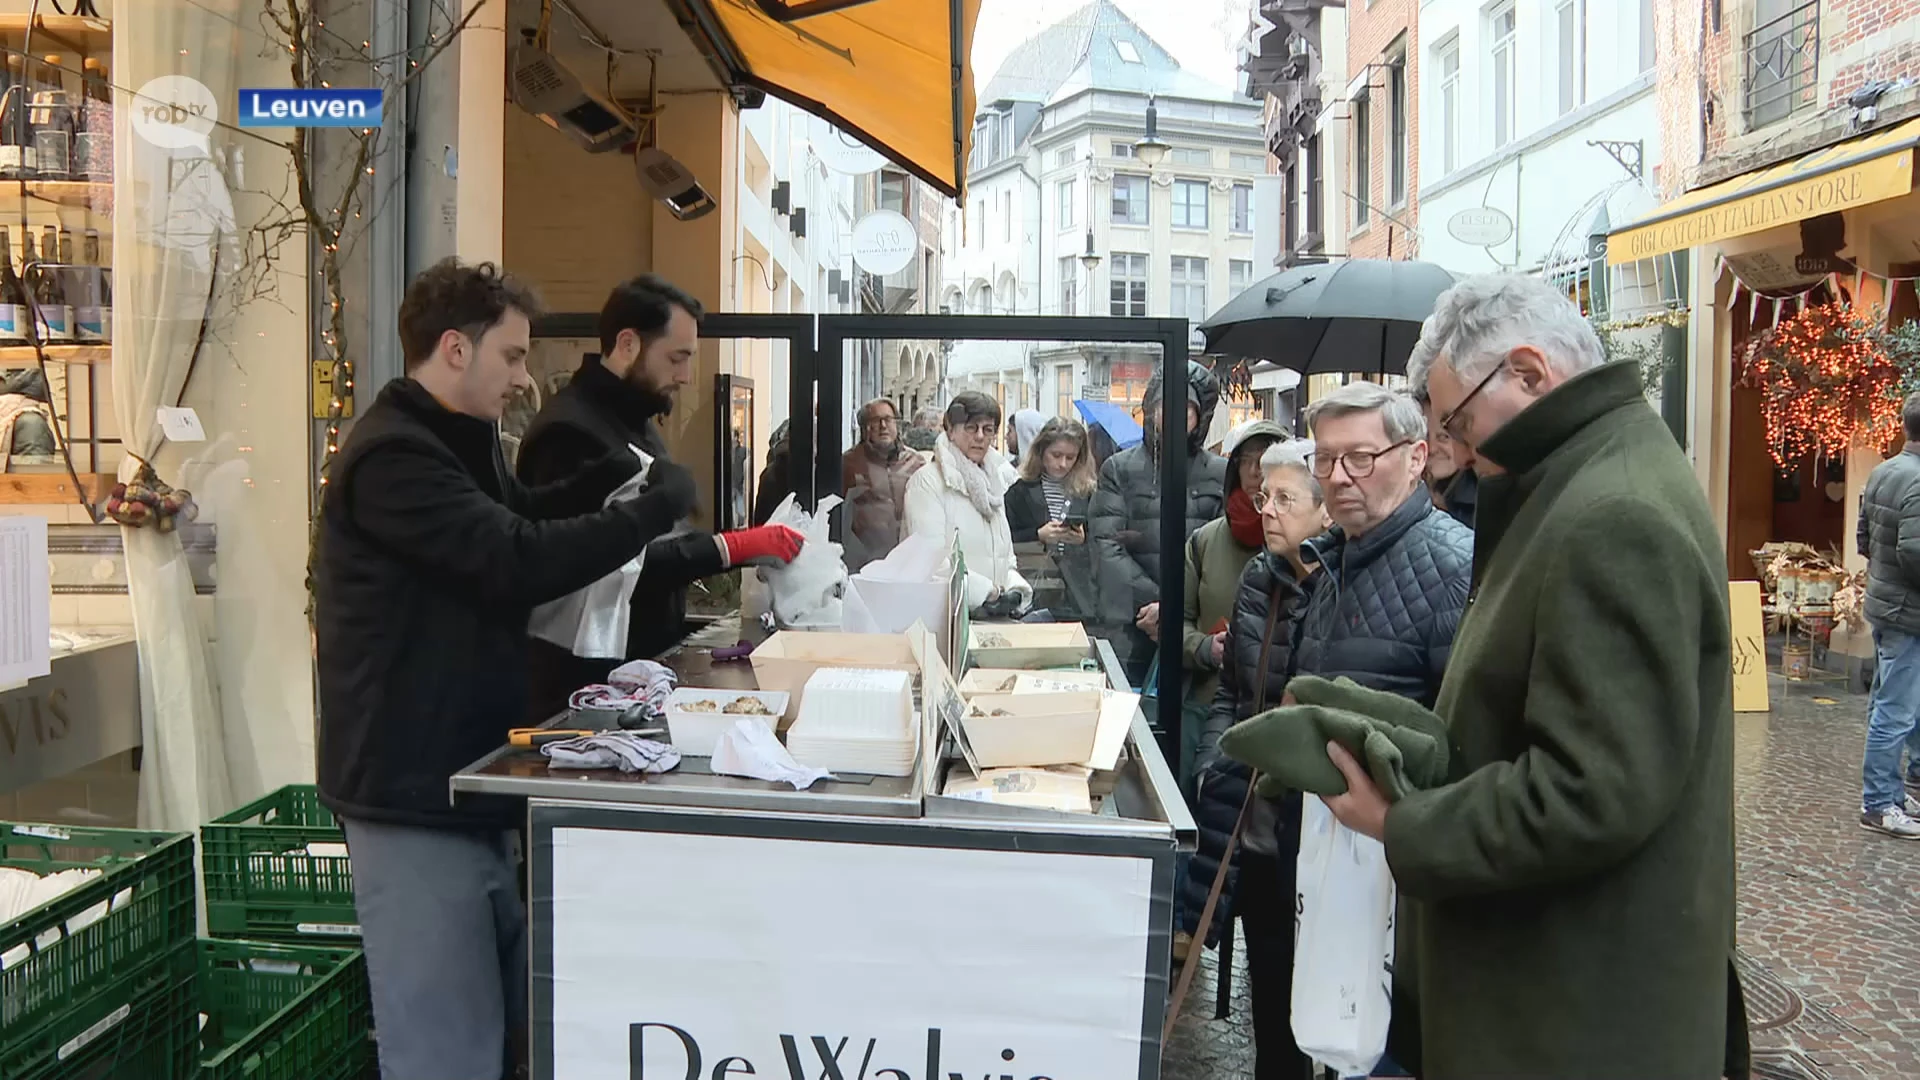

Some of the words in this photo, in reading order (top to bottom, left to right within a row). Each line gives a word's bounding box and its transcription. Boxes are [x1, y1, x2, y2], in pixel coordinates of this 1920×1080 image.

[1631, 230, 1656, 256] GIGI
[1660, 212, 1720, 249] CATCHY
[1723, 191, 1791, 233] ITALIAN
[1795, 171, 1862, 215] STORE
[629, 1022, 756, 1080] De
[779, 1027, 1056, 1080] Wli
